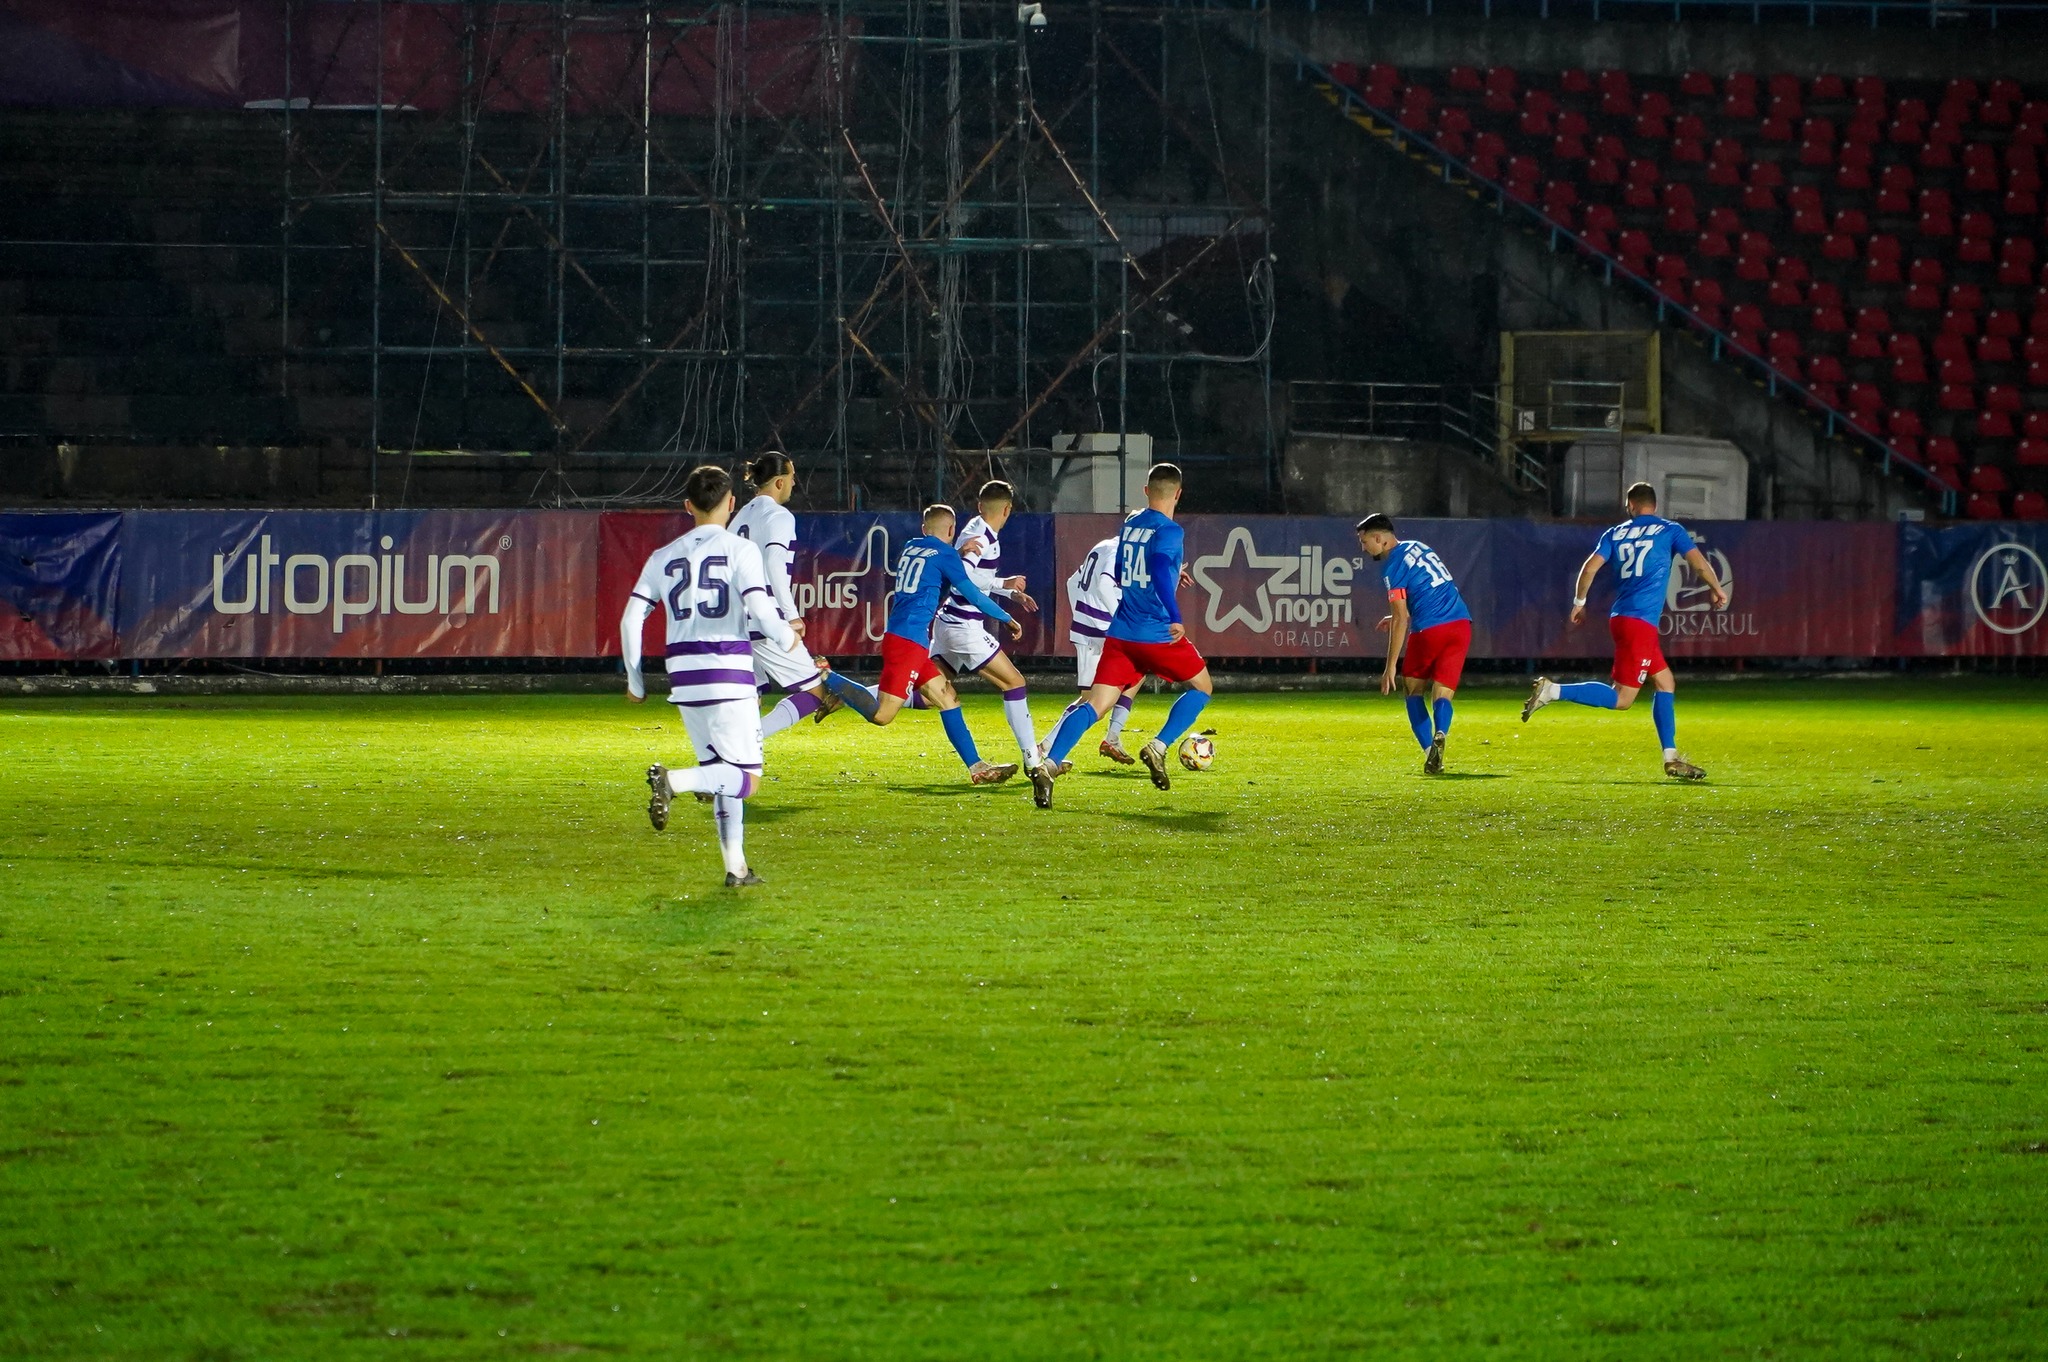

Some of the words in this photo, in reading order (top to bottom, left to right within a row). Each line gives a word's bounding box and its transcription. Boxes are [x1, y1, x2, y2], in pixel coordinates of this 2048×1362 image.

[895, 556, 926, 594] 30
[1077, 551, 1099, 592] 0
[1121, 544, 1151, 589] 34
[1267, 545, 1354, 596] zile
[1416, 551, 1453, 588] 16
[1618, 540, 1654, 579] 27
[664, 555, 730, 621] 25
[1273, 630, 1350, 648] ORADEA
[1658, 613, 1759, 636] ORSARUL
